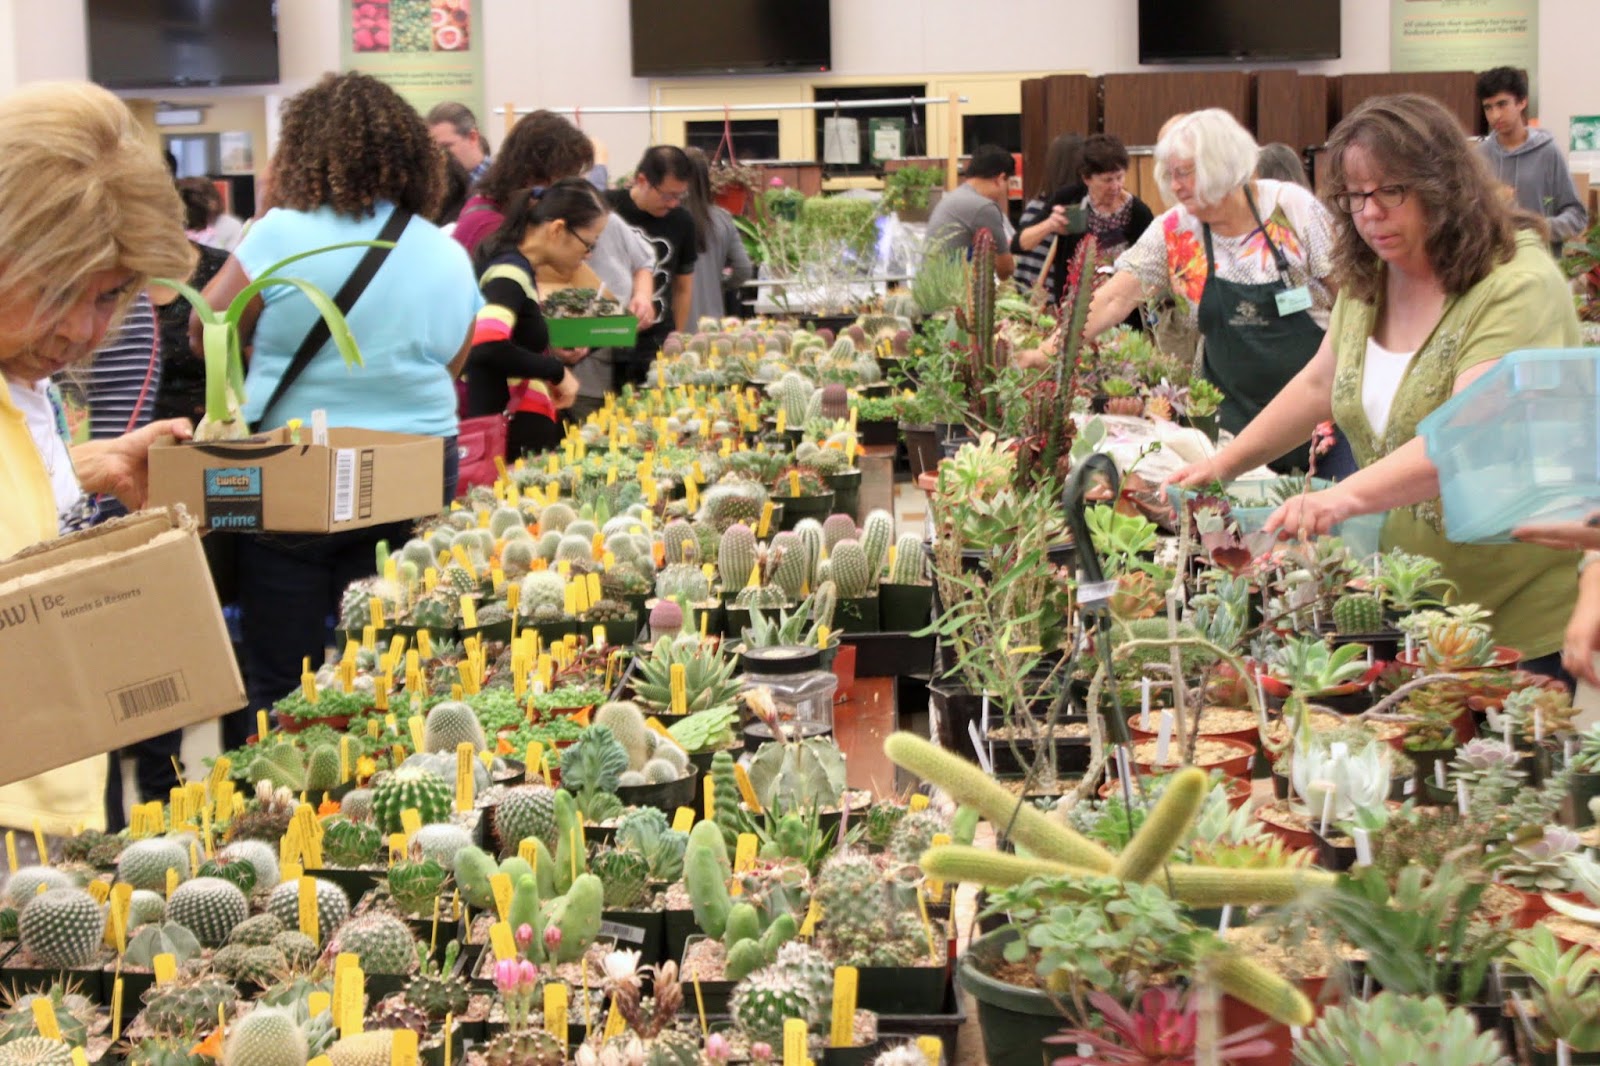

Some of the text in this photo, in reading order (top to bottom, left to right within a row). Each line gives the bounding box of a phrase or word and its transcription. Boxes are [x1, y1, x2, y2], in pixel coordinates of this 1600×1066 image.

[215, 475, 250, 487] twitch
[211, 512, 257, 530] prime
[41, 593, 66, 611] Be
[60, 588, 142, 619] Hotels & Resorts
